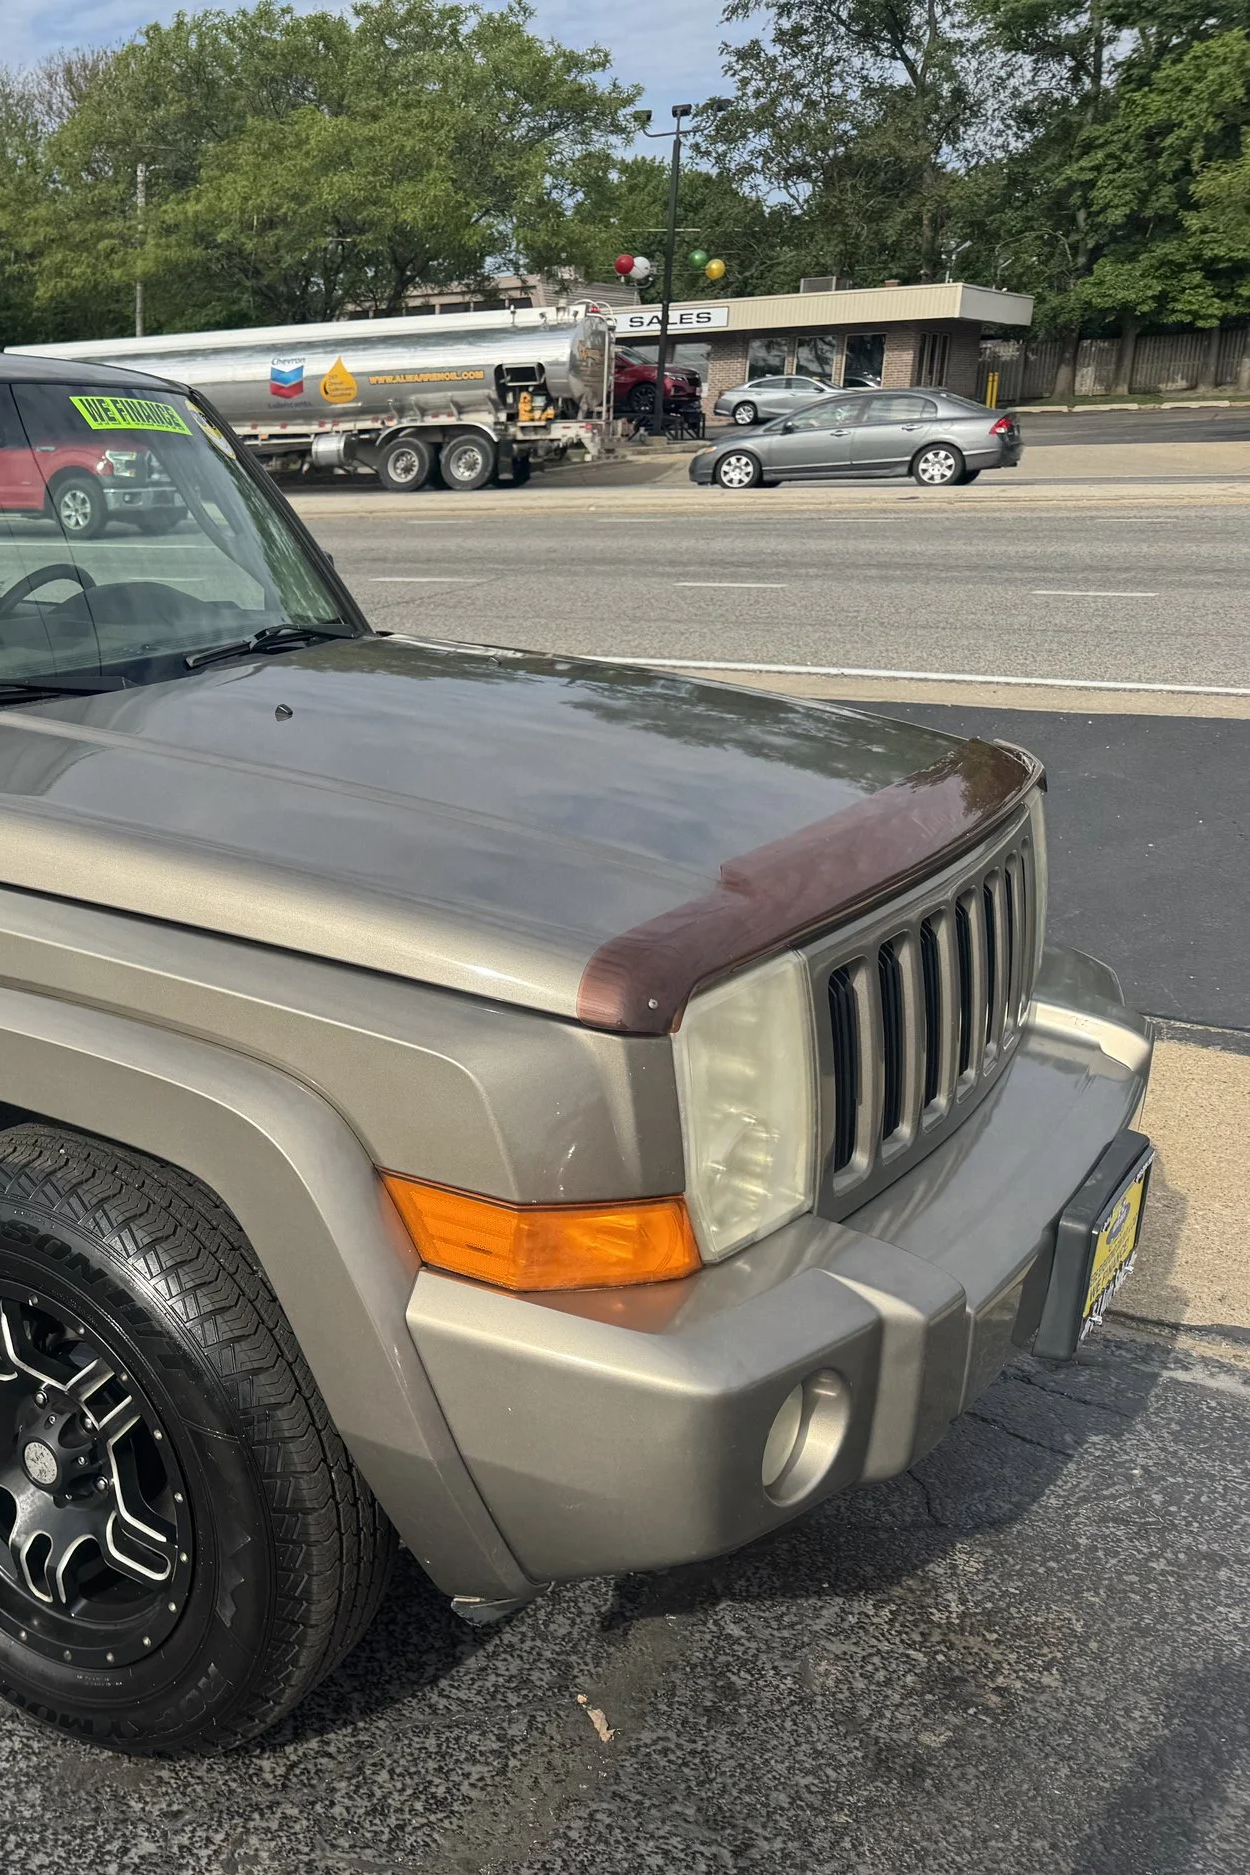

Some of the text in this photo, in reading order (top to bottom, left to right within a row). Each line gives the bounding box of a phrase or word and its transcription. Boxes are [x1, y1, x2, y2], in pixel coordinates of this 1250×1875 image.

[271, 357, 306, 367] Chevron
[78, 398, 185, 431] WE FINANCE
